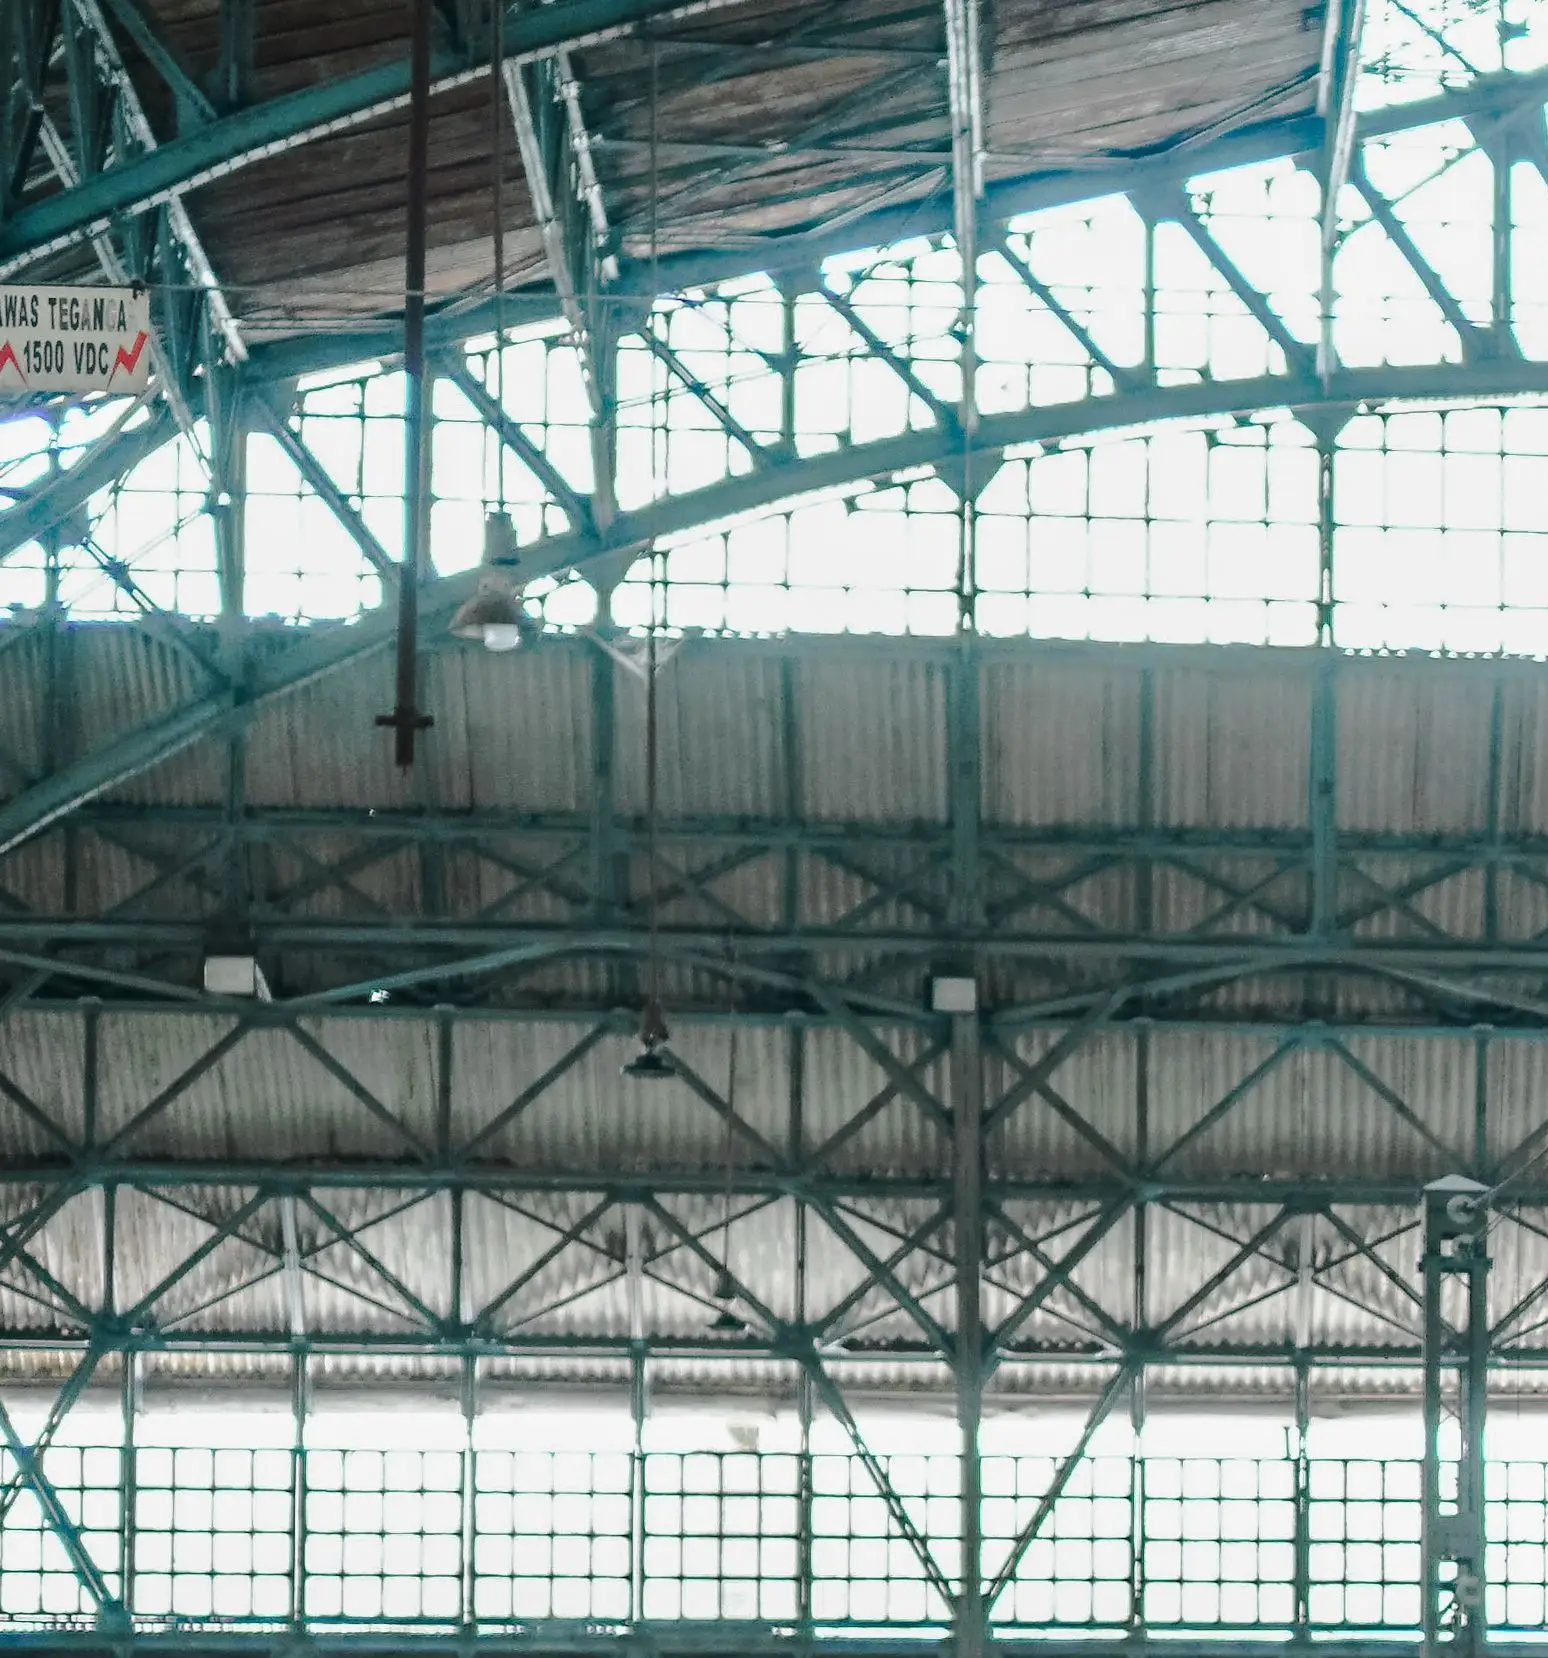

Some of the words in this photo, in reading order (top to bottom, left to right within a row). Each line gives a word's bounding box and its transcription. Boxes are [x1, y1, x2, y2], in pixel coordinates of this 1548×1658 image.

[48, 297, 128, 332] TEGANGA
[24, 340, 64, 374] 1500
[74, 342, 109, 375] VDC
